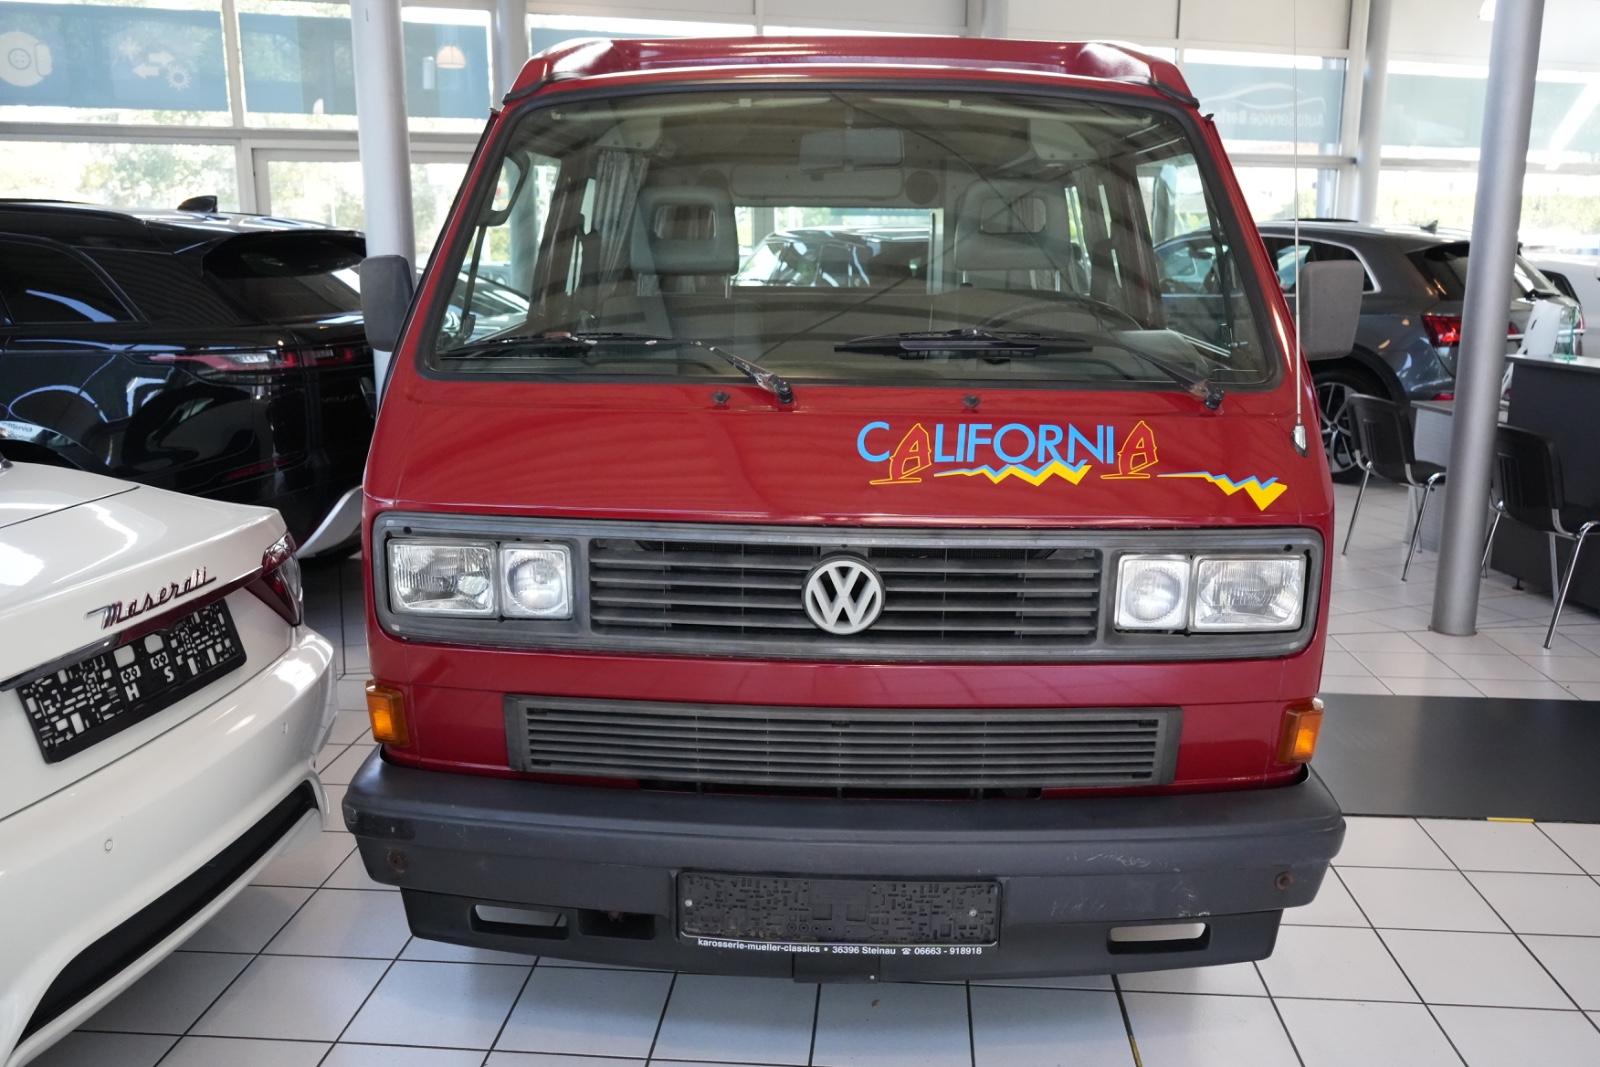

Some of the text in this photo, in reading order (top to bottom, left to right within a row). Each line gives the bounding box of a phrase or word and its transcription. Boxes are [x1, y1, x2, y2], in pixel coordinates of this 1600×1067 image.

[856, 420, 1159, 485] CALIFORNIA
[86, 566, 216, 630] Maserati
[805, 560, 882, 635] VW
[697, 938, 820, 953] karosserie-mueller-classics
[832, 945, 860, 954] 36396
[861, 946, 896, 955] Steinau
[914, 947, 941, 955] 06663
[949, 946, 982, 955] 918918
